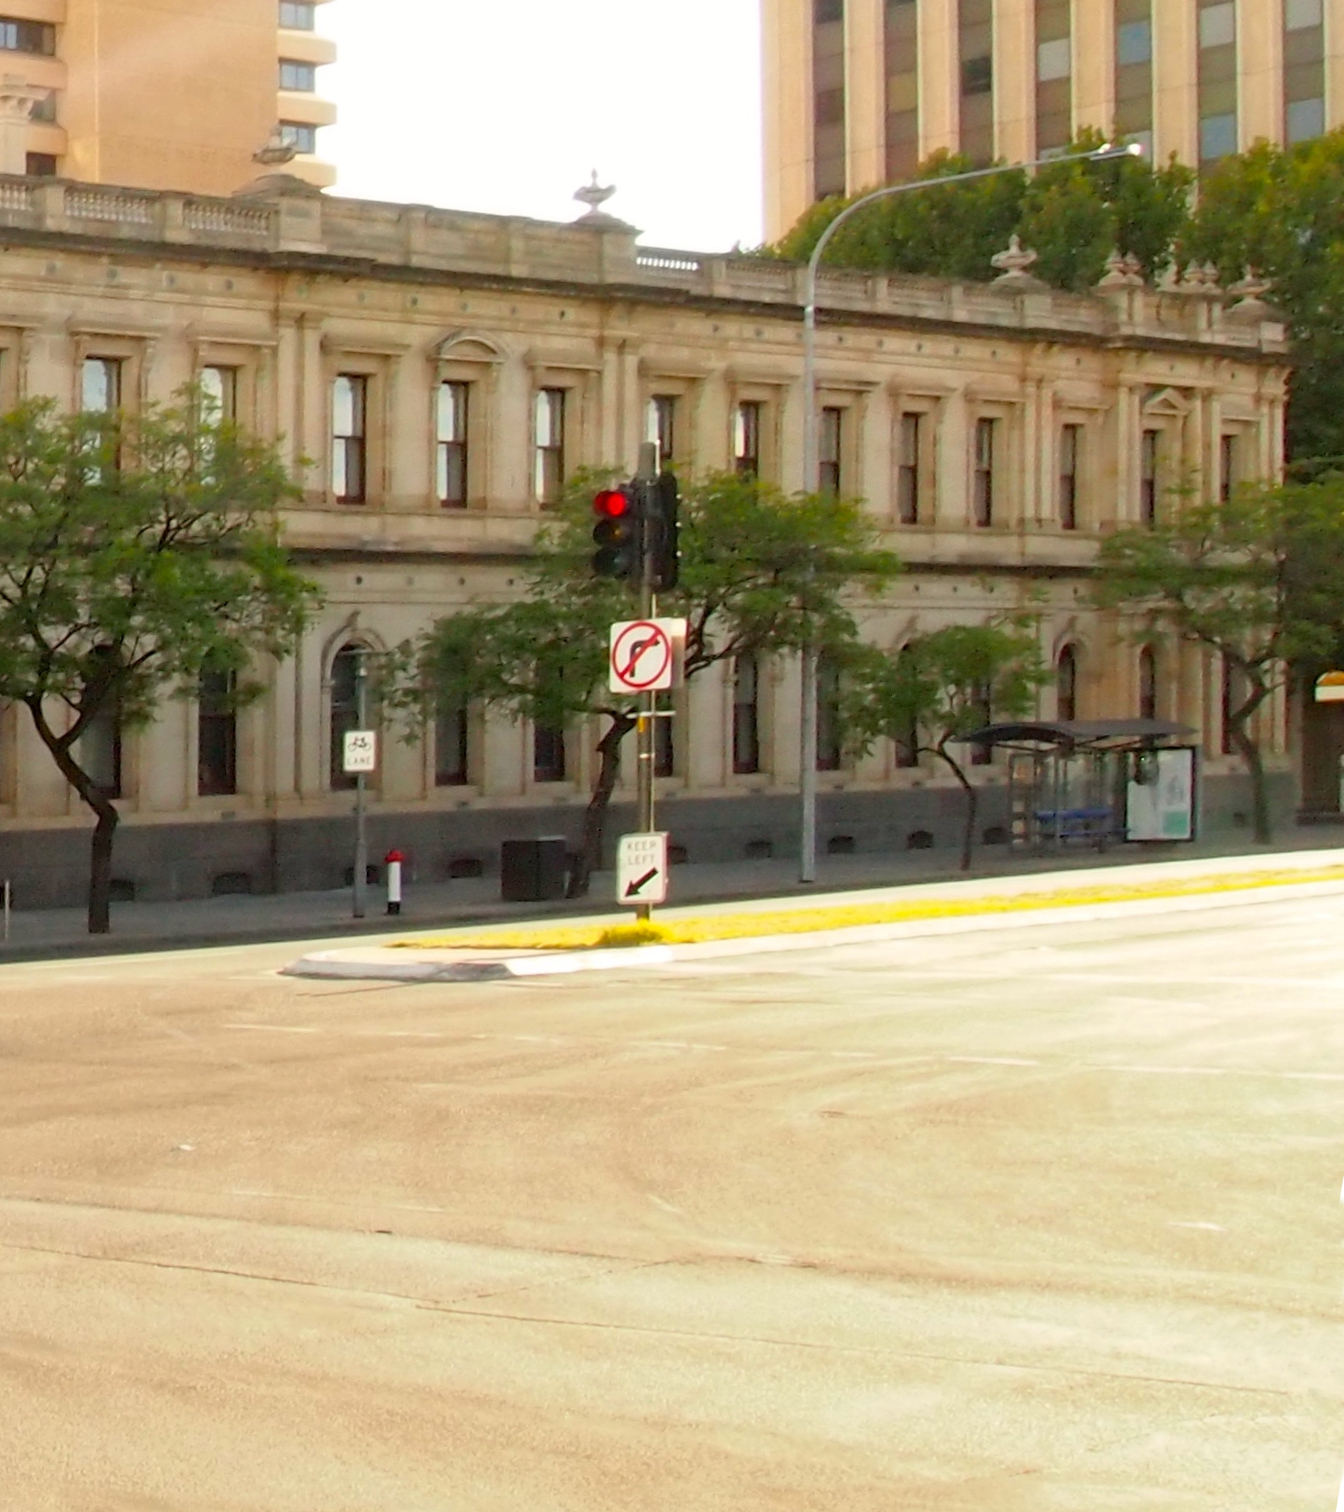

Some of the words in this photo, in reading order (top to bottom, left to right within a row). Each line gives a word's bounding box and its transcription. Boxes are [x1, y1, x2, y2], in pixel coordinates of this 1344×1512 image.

[347, 756, 371, 766] LANE
[627, 840, 656, 852] KEEP
[627, 854, 654, 866] LEFT
